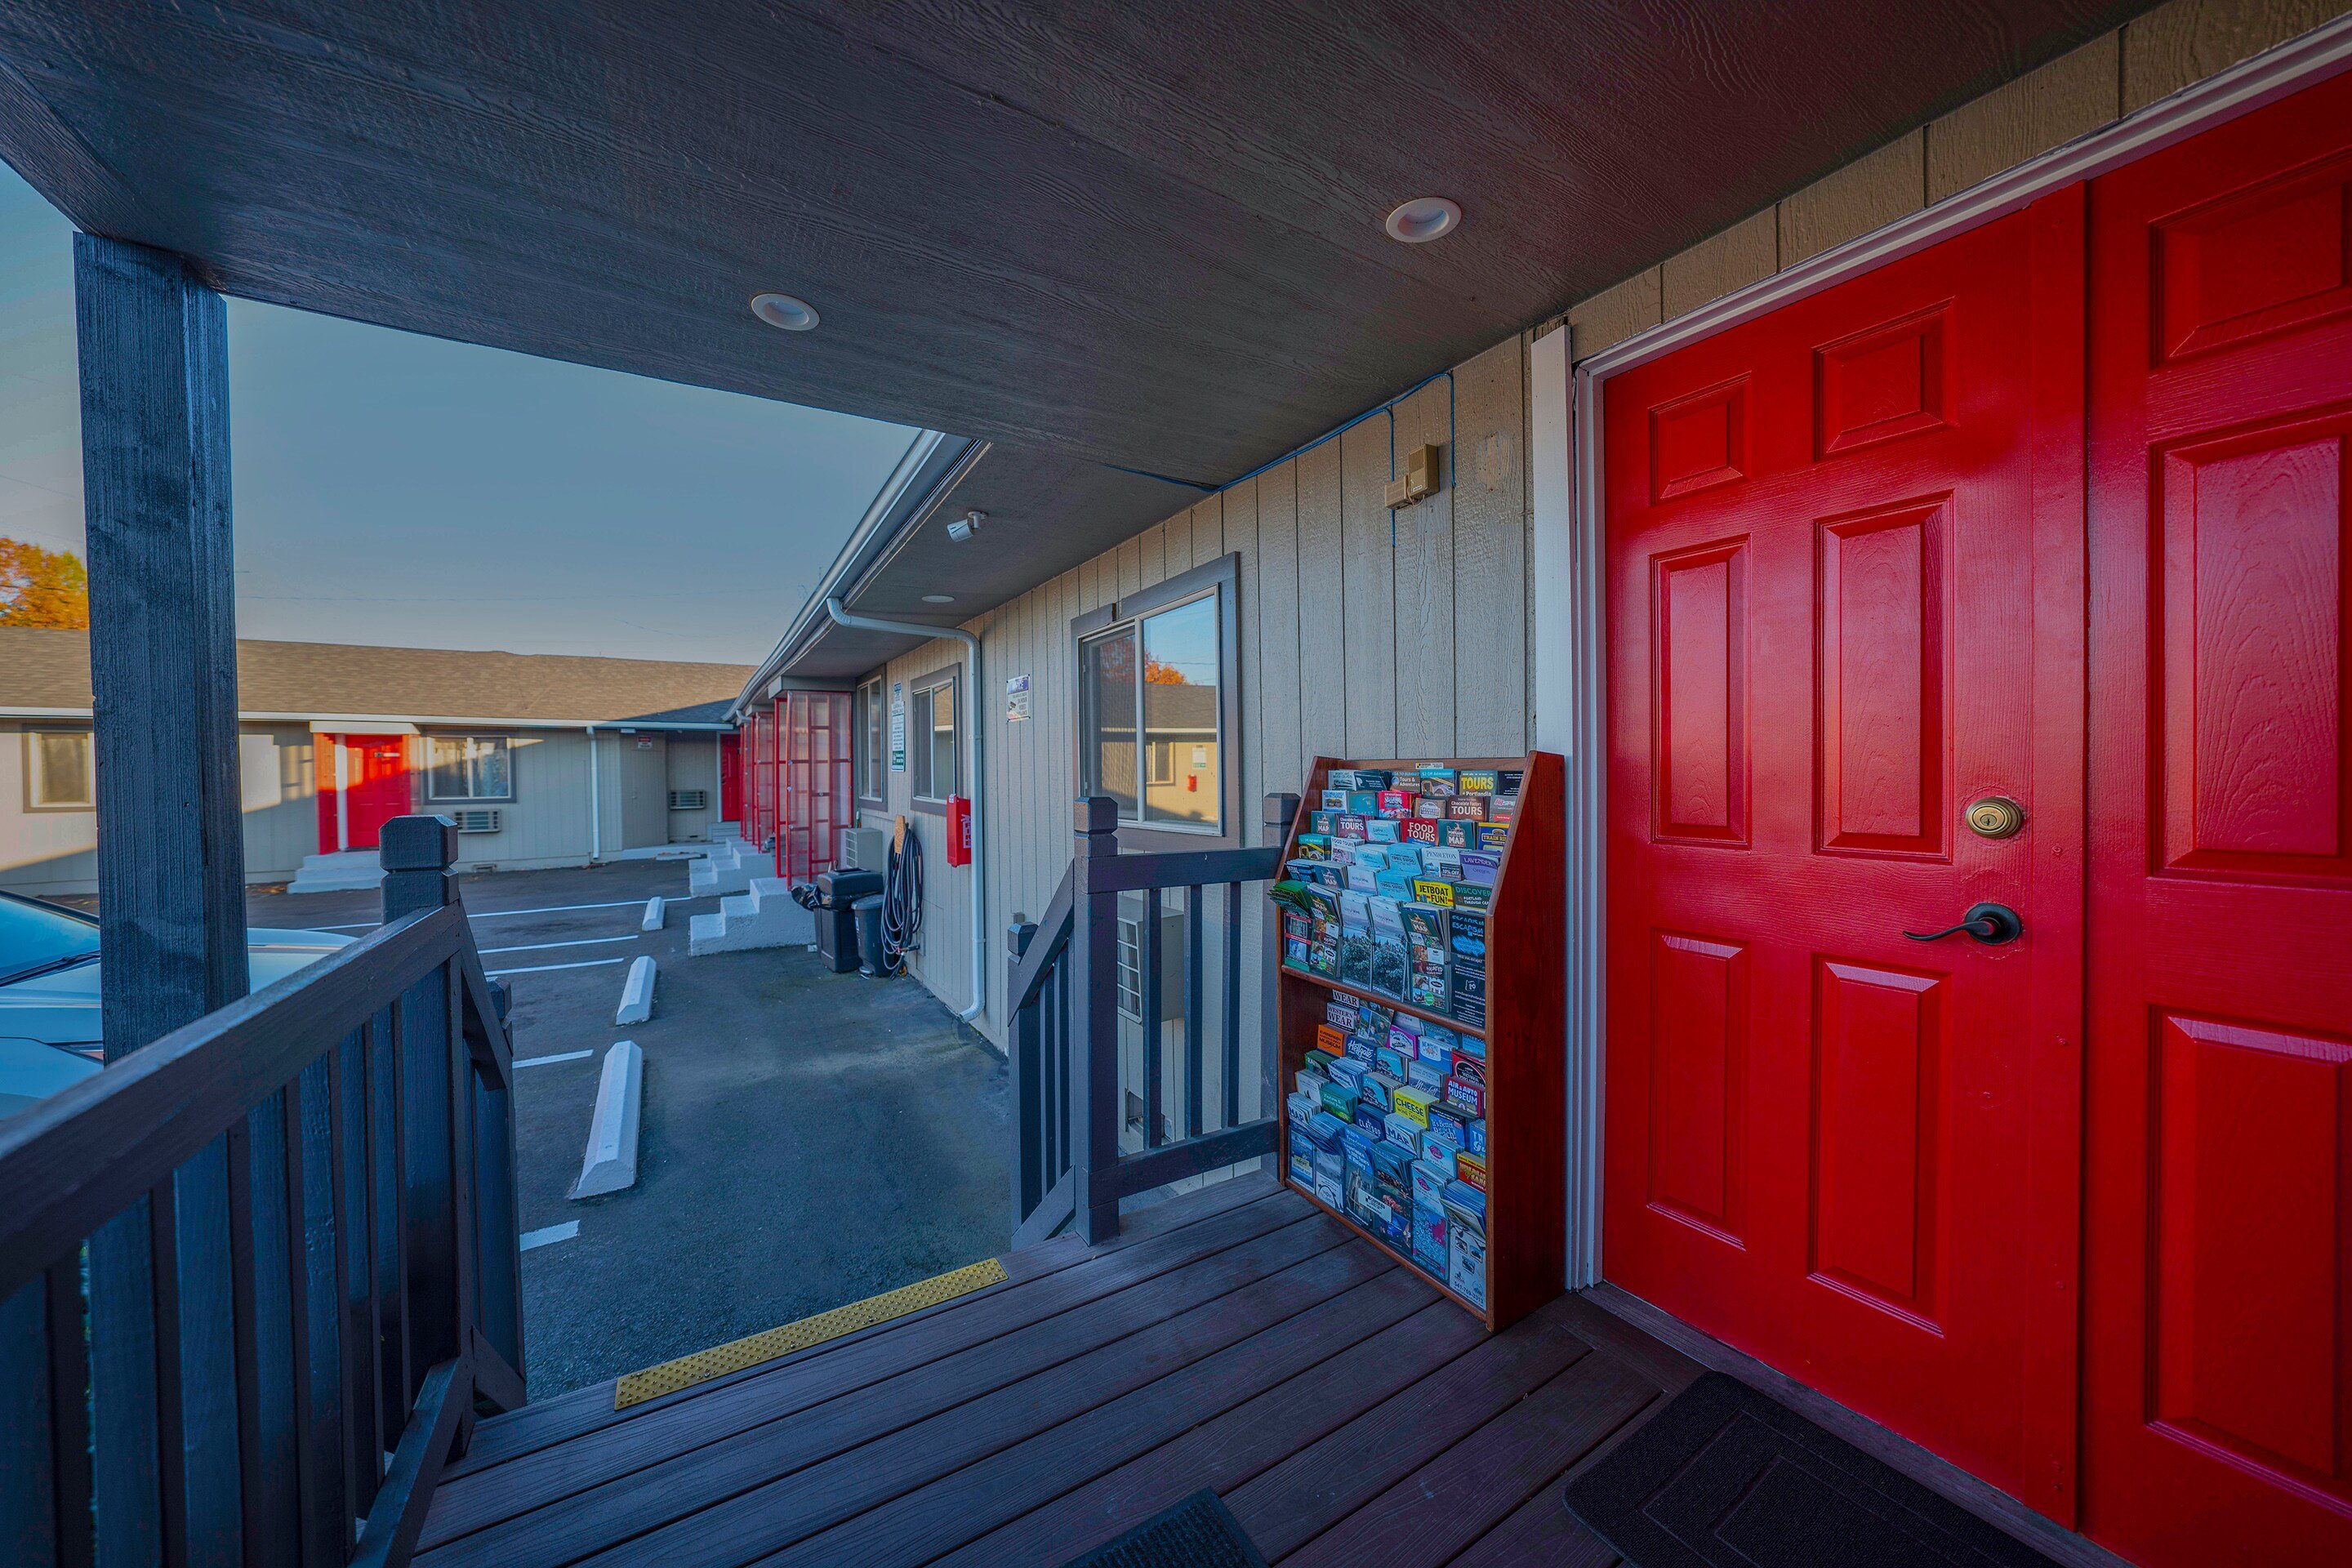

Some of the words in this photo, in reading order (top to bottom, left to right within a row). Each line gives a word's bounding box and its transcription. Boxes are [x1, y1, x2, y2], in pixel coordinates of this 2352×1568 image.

[1461, 777, 1494, 790] TOURS
[1451, 806, 1483, 815] TOURS
[1340, 822, 1364, 831] TOURS
[1409, 822, 1434, 833] FOOD
[1407, 829, 1436, 842] TOURS
[1448, 836, 1464, 844] MAP
[1426, 850, 1457, 859] PENDLETON
[1419, 884, 1449, 896] JETBOAT
[1455, 886, 1492, 897] DISCOVER
[1431, 894, 1448, 905] FUN!
[1413, 924, 1428, 933] MAP
[1333, 991, 1358, 1006] WEAR
[1327, 1006, 1353, 1018] WESTERN
[1328, 1012, 1352, 1029] WEAR
[1348, 1040, 1374, 1058] Hellgate
[1449, 1080, 1459, 1089] AIR
[1462, 1085, 1478, 1096] AUTO
[1448, 1087, 1477, 1105] MUSEUM
[1396, 1098, 1424, 1116] CHEESE
[1289, 1107, 1304, 1122] MAP
[1387, 1126, 1409, 1144] MAP
